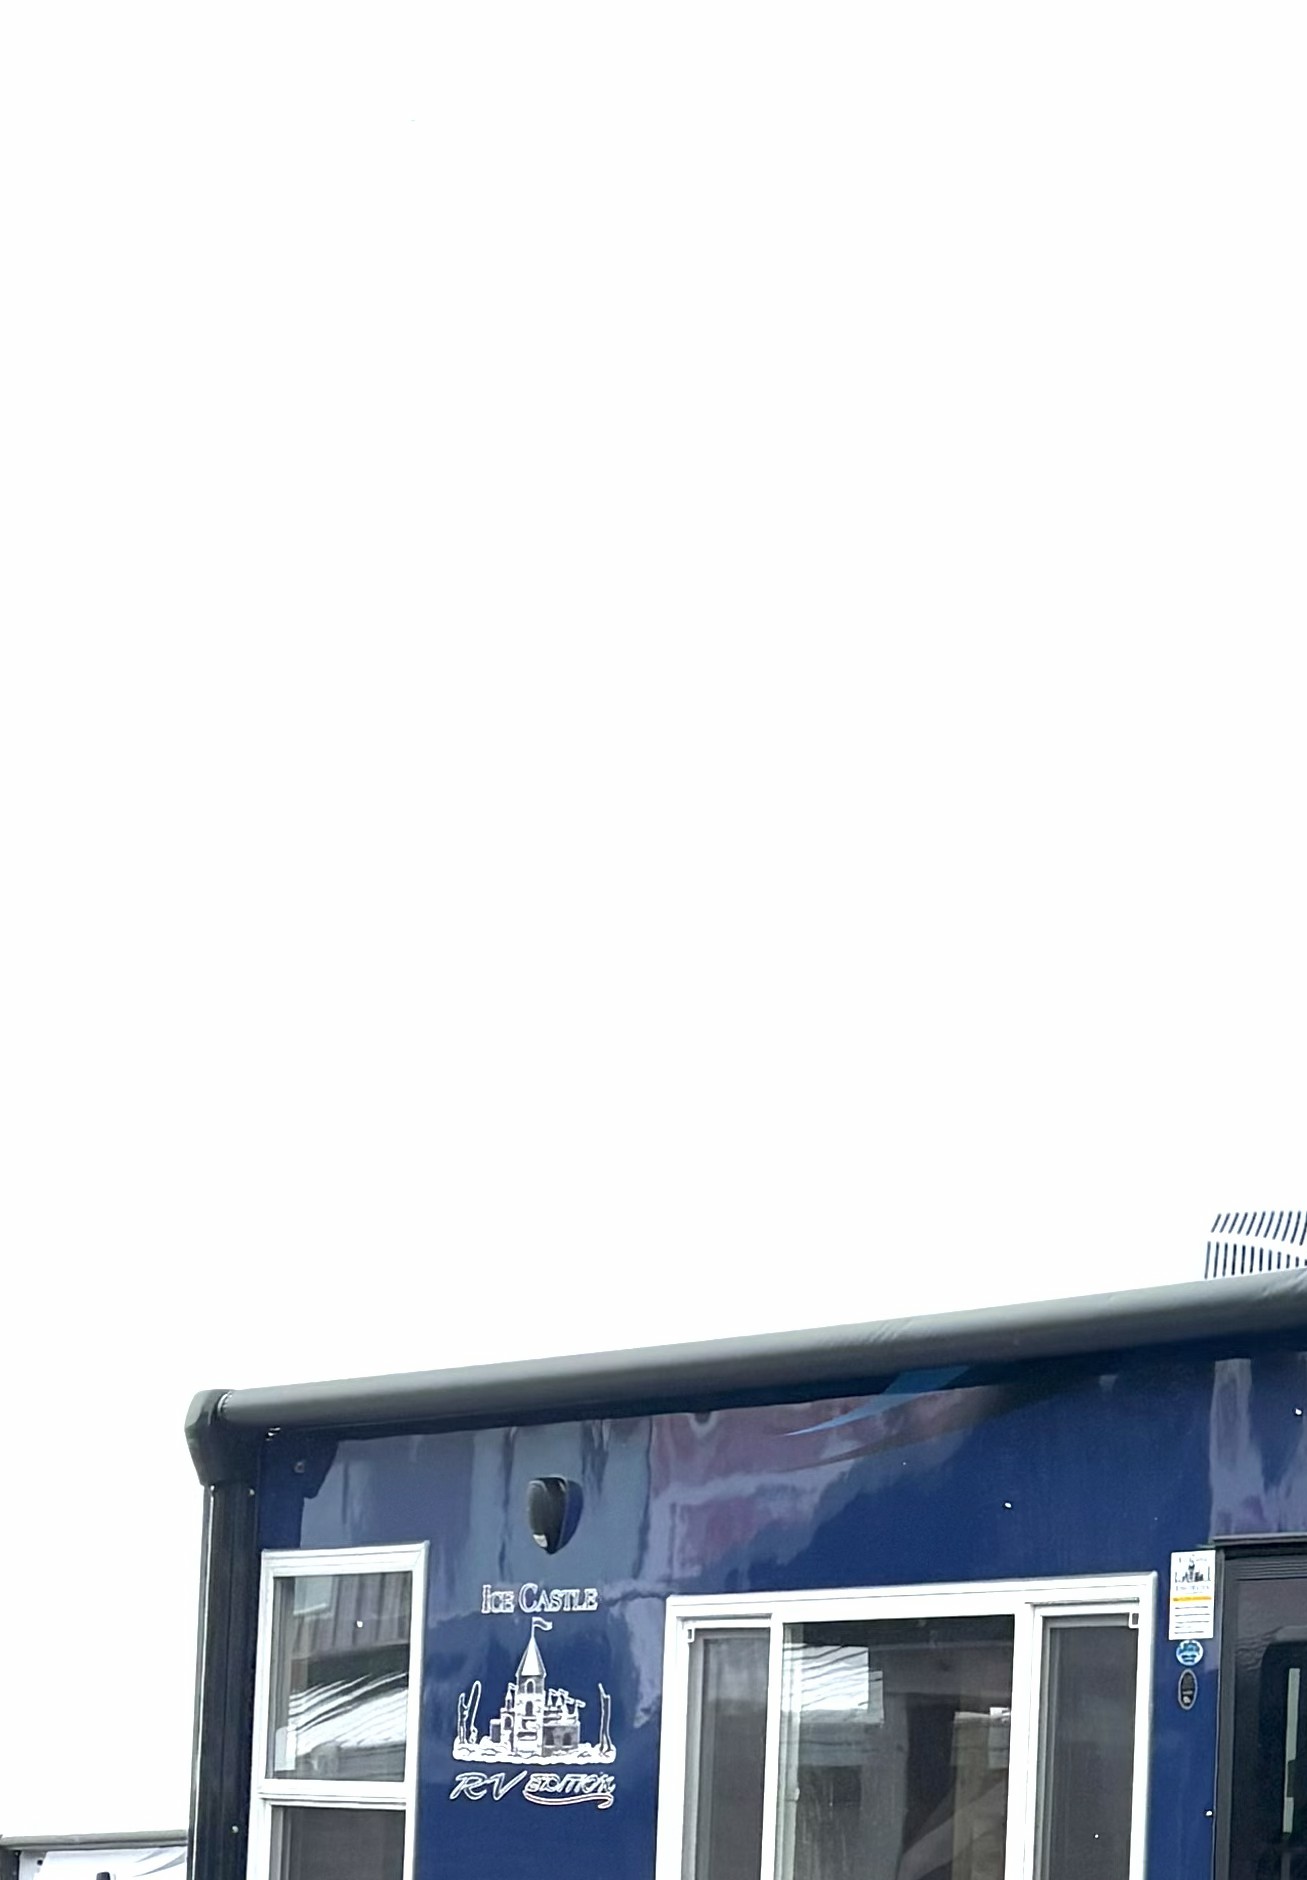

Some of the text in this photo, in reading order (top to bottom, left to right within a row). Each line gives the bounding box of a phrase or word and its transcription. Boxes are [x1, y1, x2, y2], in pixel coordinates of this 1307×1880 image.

[481, 1583, 598, 1614] ICE CASTLE
[450, 1771, 527, 1800] RV
